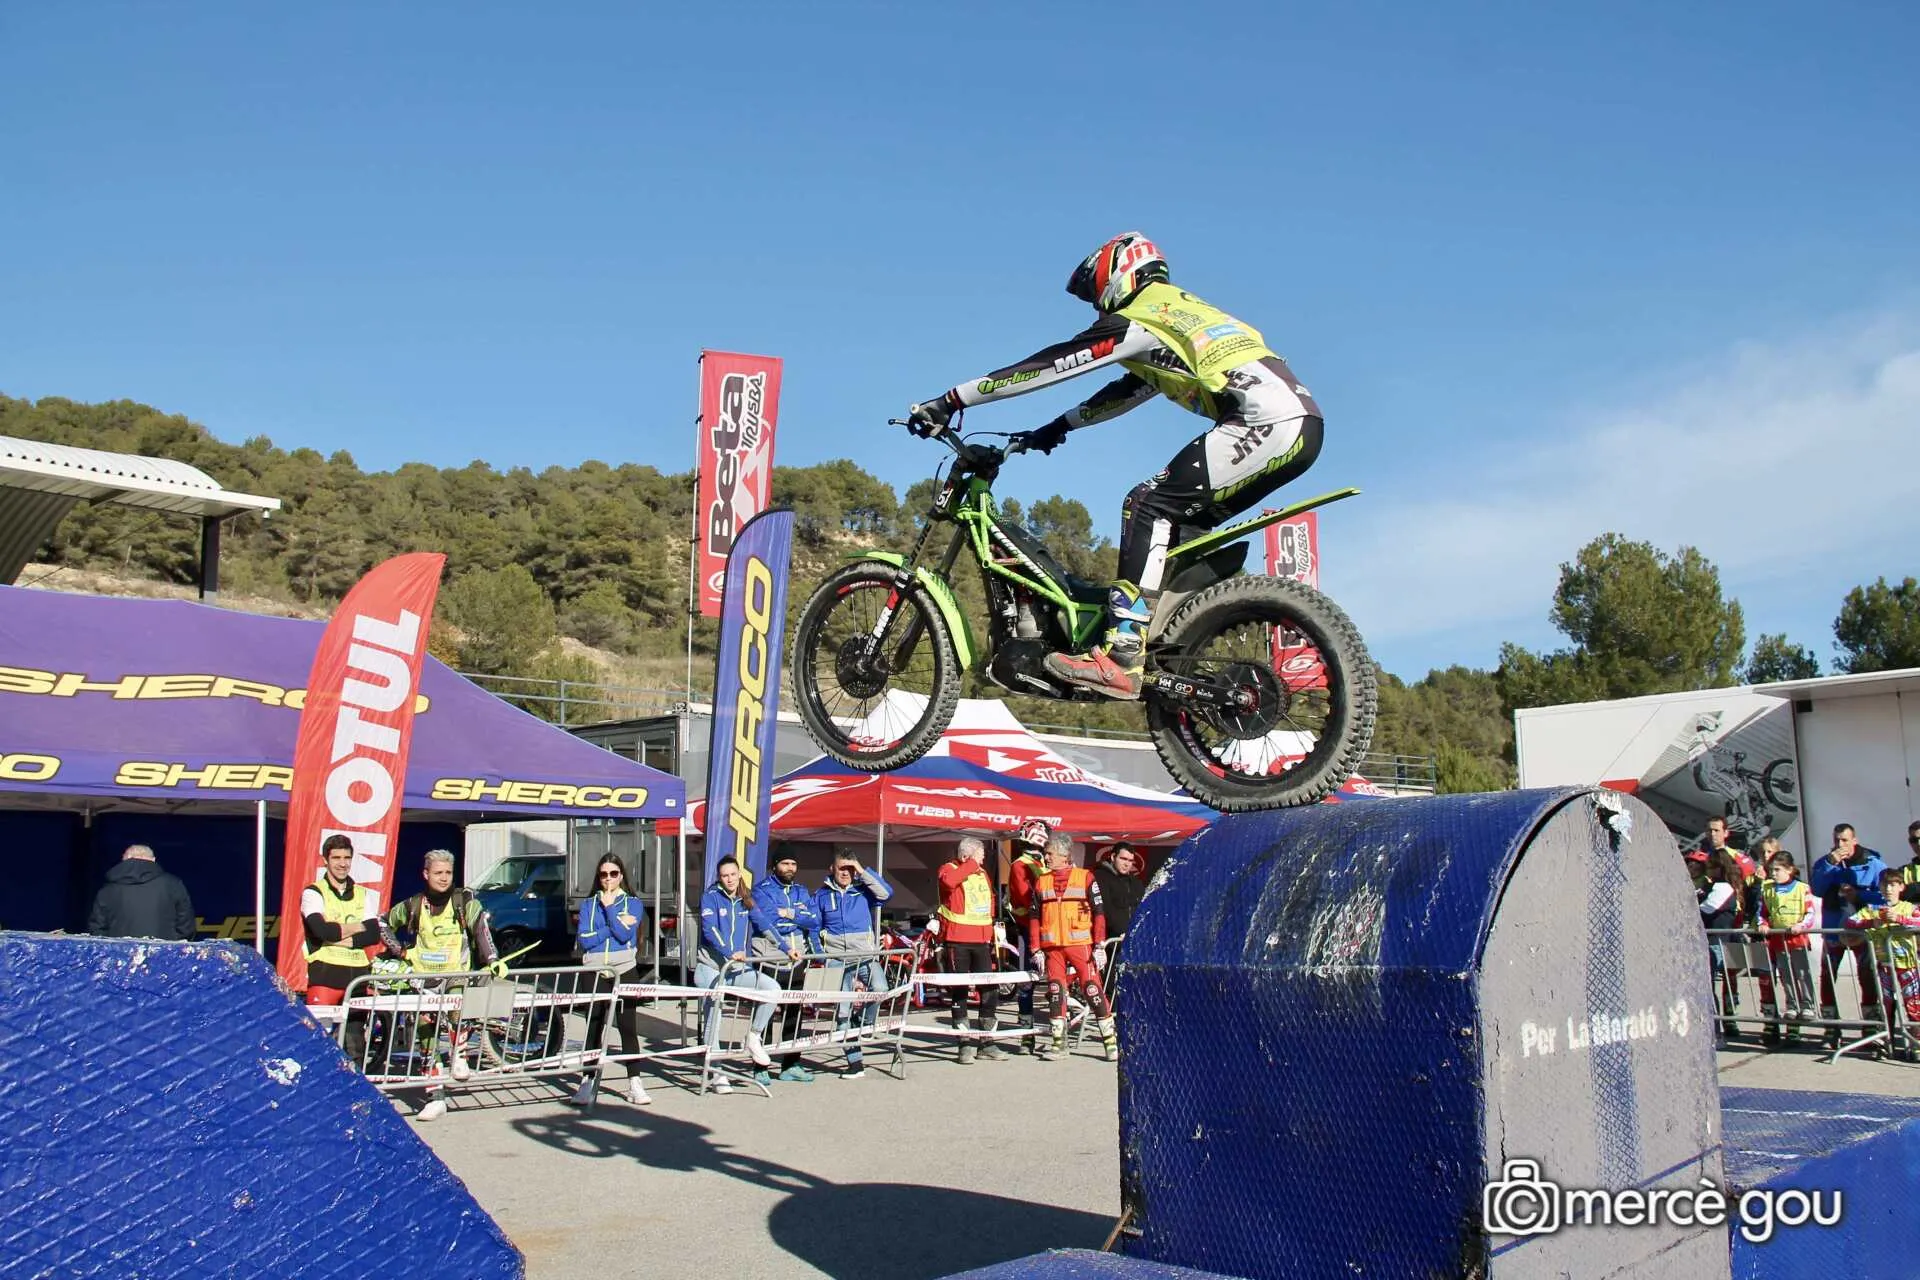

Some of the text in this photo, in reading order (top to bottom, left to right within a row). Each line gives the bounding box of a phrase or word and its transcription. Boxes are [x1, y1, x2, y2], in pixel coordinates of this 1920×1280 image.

[1054, 337, 1117, 374] MRW
[710, 373, 745, 557] Beta
[0, 665, 430, 713] SHER
[728, 556, 773, 890] HERCO
[115, 761, 294, 791] SHER
[316, 608, 422, 917] MOTUL
[431, 778, 649, 810] SHERCO
[427, 996, 462, 1010] octag
